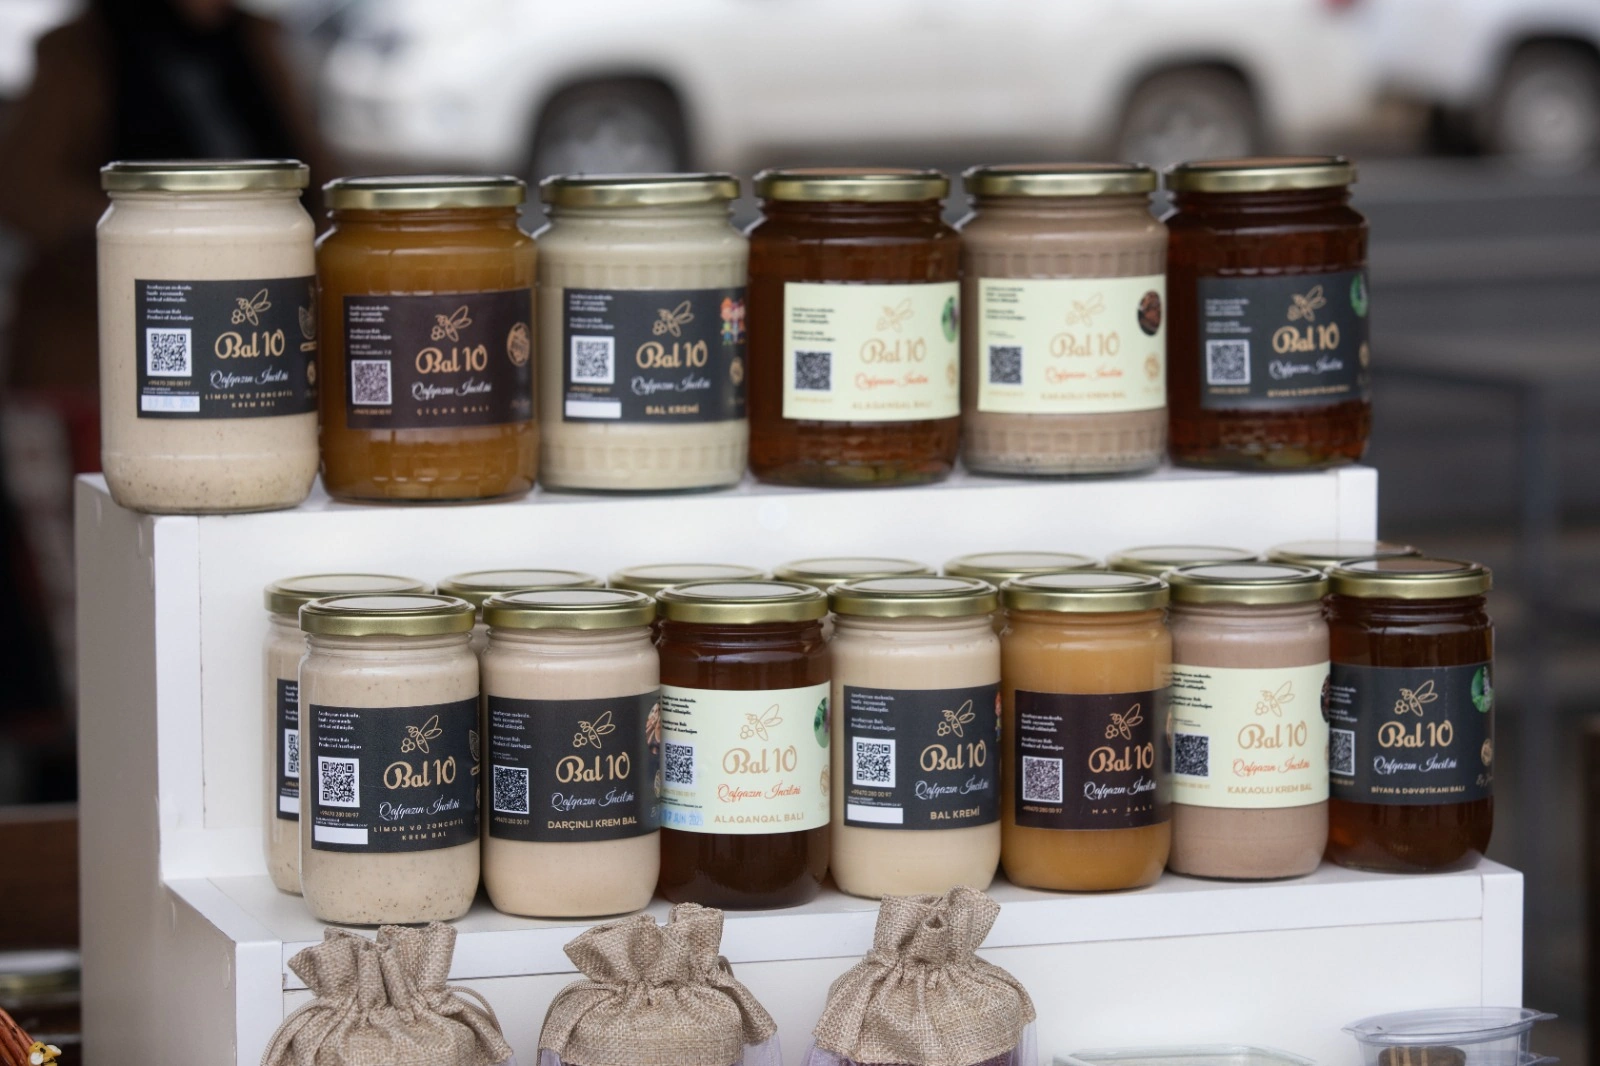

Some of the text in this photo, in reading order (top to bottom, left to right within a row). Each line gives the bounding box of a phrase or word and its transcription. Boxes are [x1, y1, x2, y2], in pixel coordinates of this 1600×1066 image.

[215, 328, 285, 359] Bal 10
[860, 336, 926, 364] Bal 10
[1050, 331, 1120, 358] Bal 10
[1272, 322, 1340, 354] Bal 10
[415, 344, 488, 374] Bal 10
[636, 340, 708, 369] Bal 10
[646, 406, 666, 414] BAL
[1238, 720, 1308, 750] Bal 10
[1378, 719, 1453, 748] Bal 10
[556, 752, 630, 783] Bal 10
[722, 745, 798, 774] Bal 10
[920, 740, 987, 772] Bal 10
[1088, 742, 1154, 773] Bal 10
[384, 756, 456, 790] Bal 10
[551, 792, 596, 812] Qafqazın
[718, 784, 762, 803] Qafqazın
[1084, 781, 1126, 800] Qafqazın
[1228, 783, 1312, 795] KAKAOLU KREM BAL
[379, 802, 424, 821] Qafqazın
[595, 818, 621, 828] KREM
[622, 816, 637, 825] BAL
[714, 812, 804, 823] ALAQANQAL BALI
[930, 806, 980, 820] BAL KREMİ
